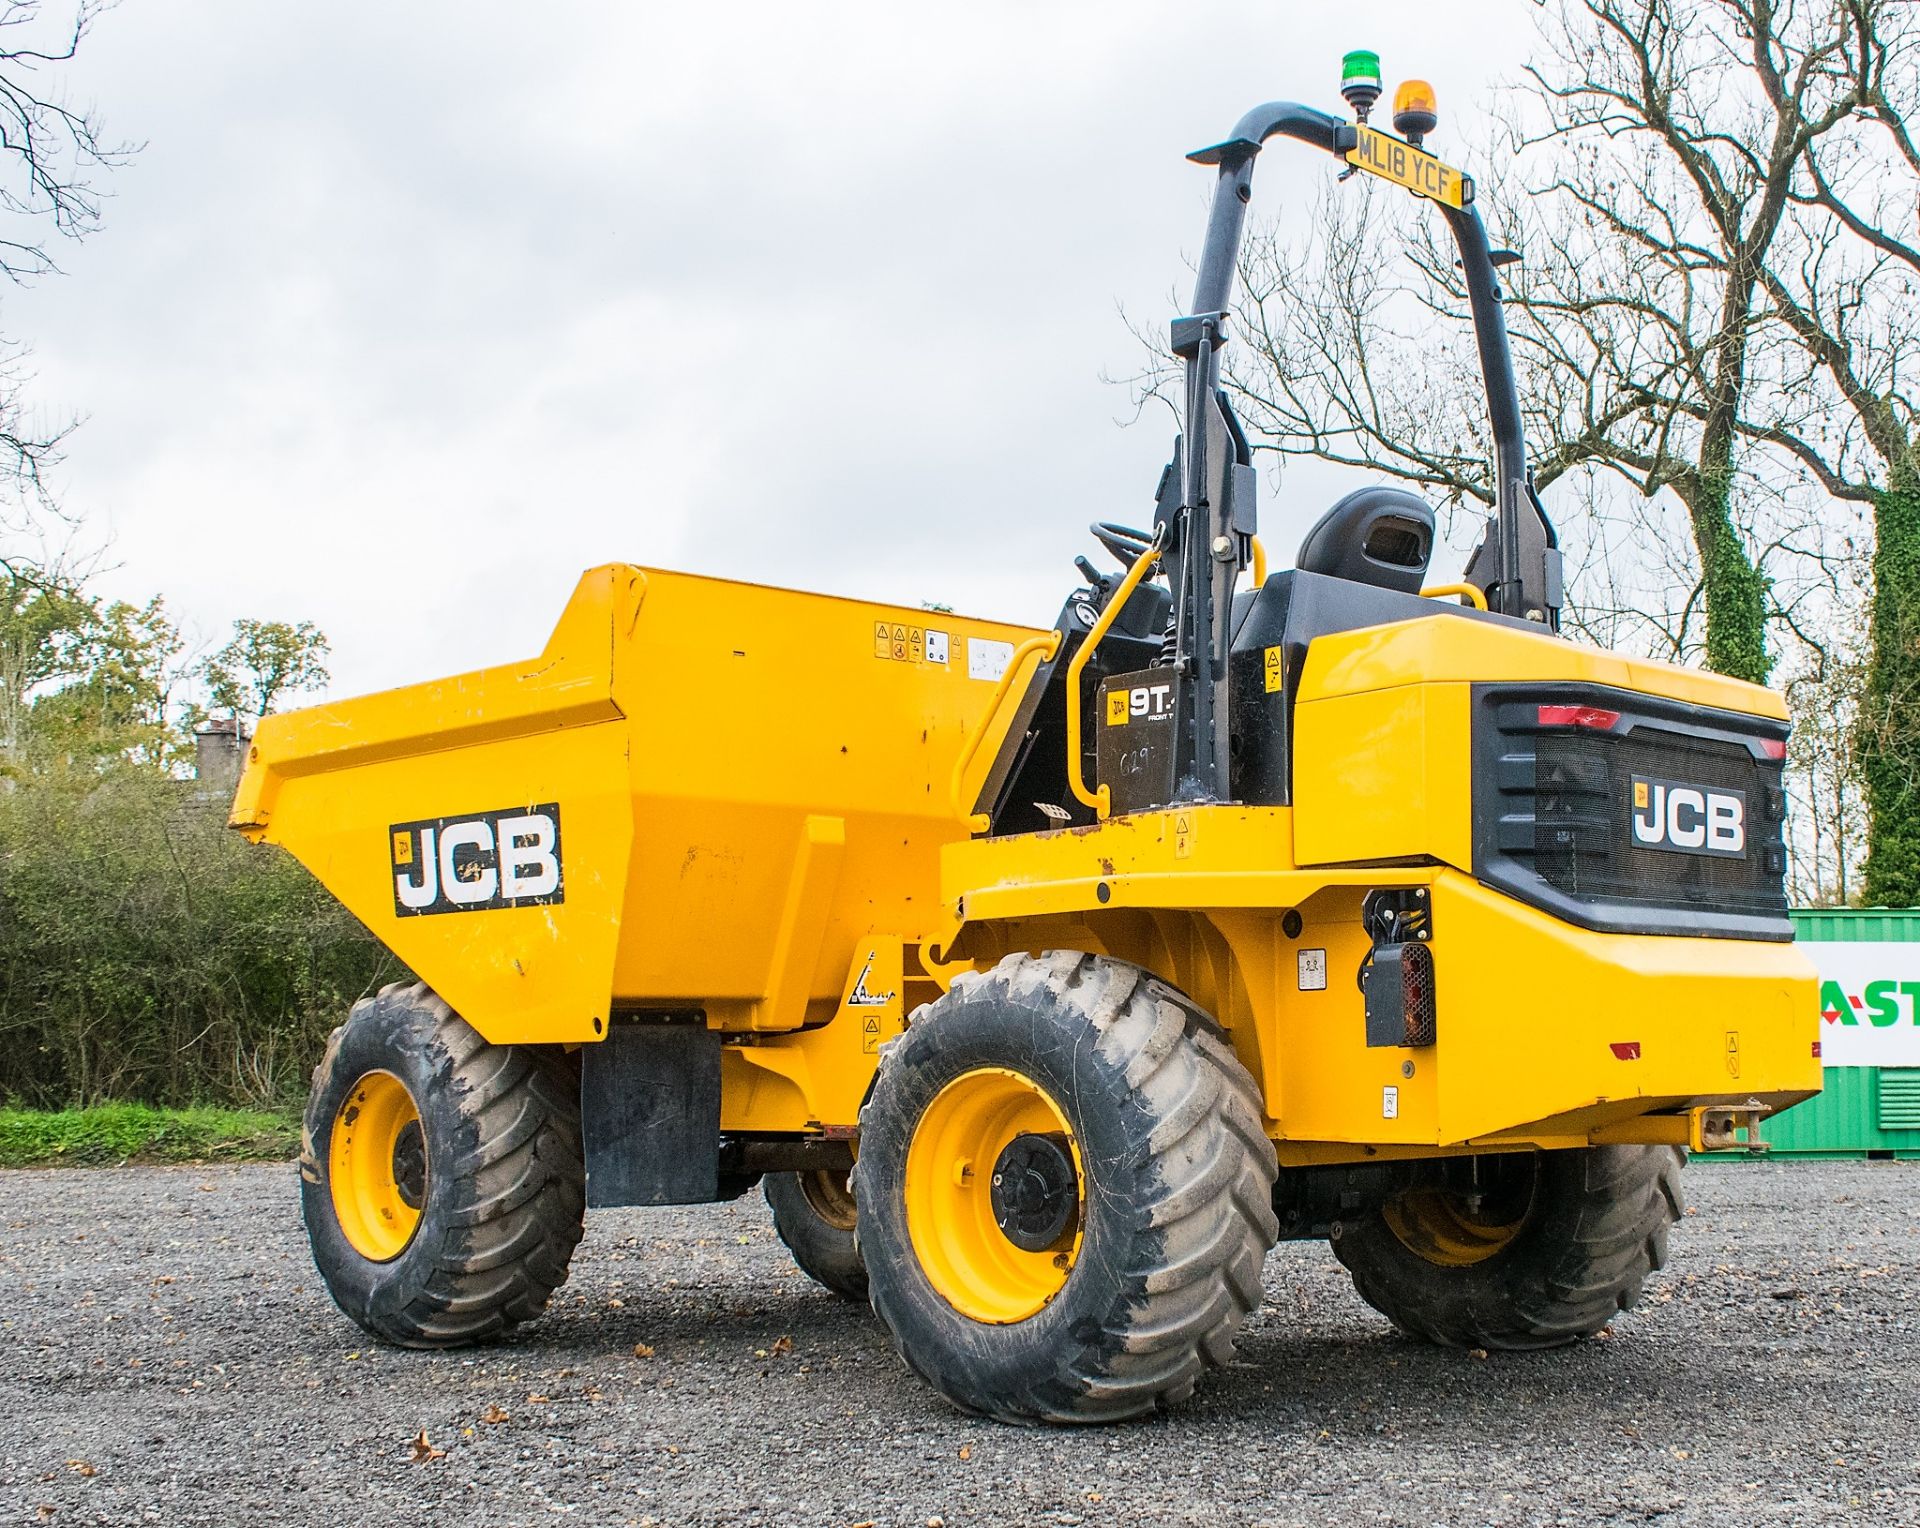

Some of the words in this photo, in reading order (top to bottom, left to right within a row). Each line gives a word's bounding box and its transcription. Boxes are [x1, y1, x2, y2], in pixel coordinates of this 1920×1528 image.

[1359, 130, 1406, 178] ML18
[1412, 153, 1450, 196] YCF
[1147, 713, 1169, 722] FRONT
[1634, 785, 1745, 852] JCB
[396, 814, 560, 908] JCB
